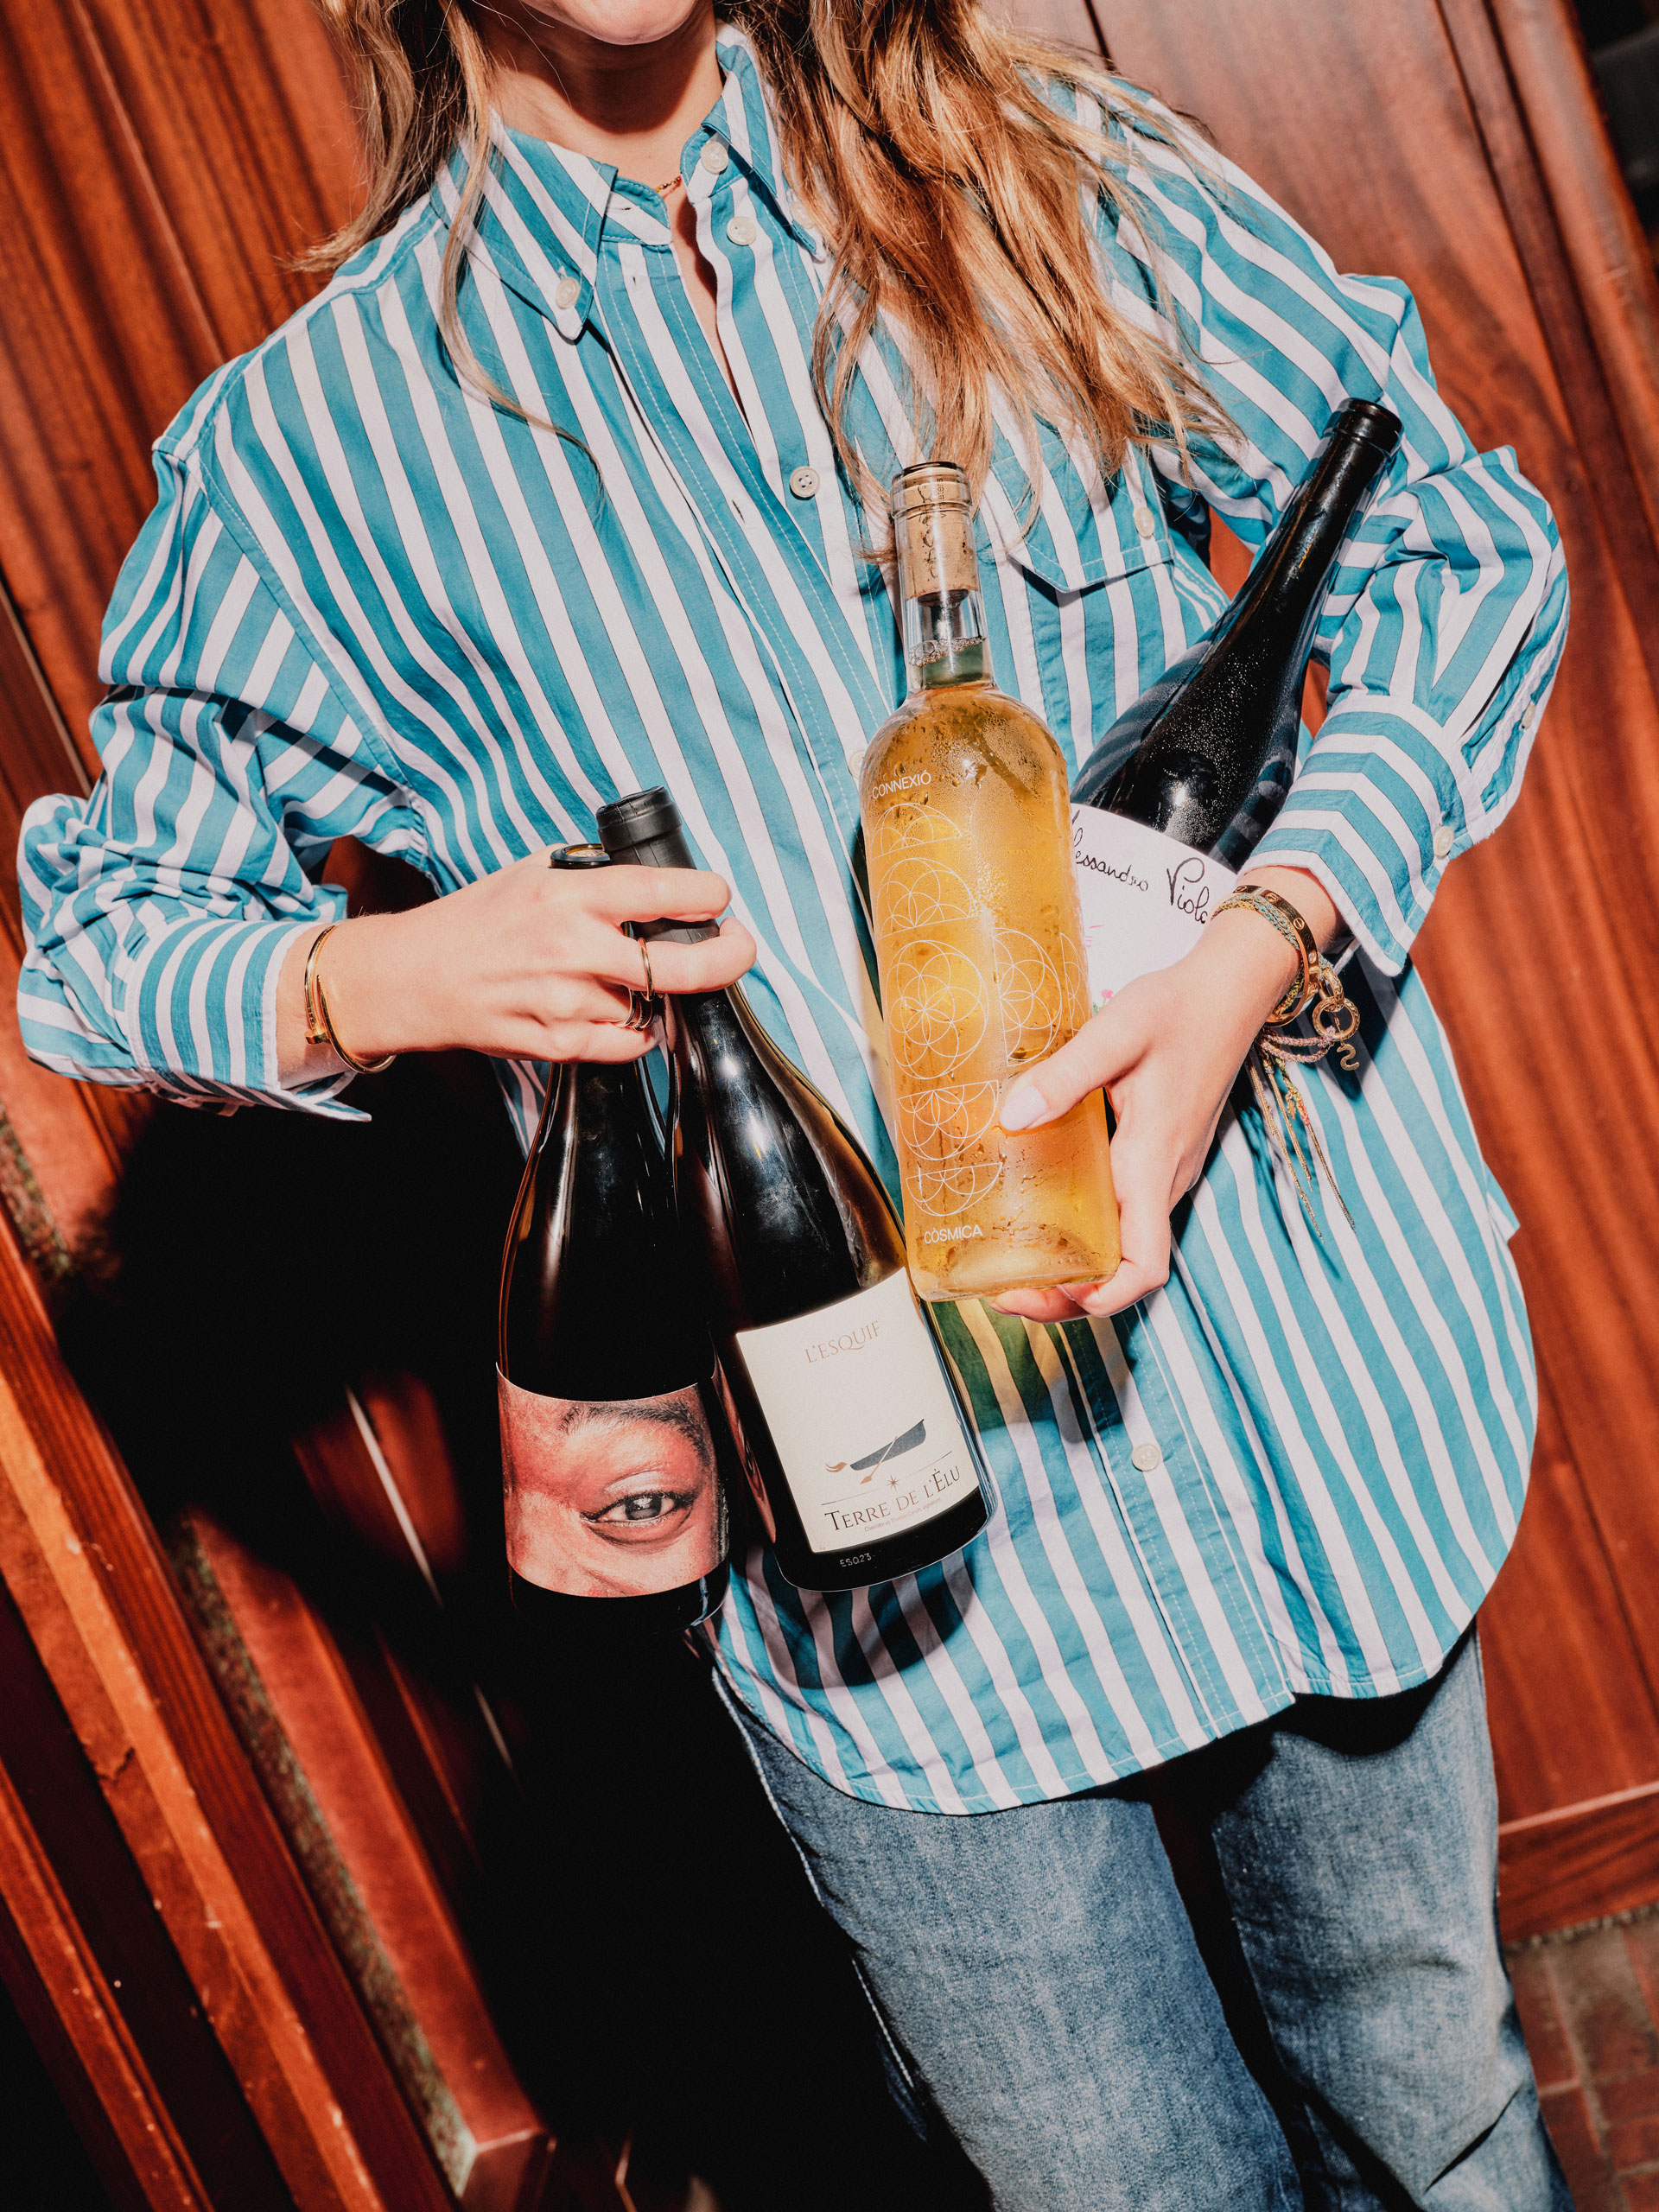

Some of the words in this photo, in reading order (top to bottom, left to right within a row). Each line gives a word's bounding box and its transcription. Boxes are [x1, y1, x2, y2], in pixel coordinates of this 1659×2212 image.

[1071, 810, 1148, 892] lessandro
[804, 1319, 880, 1363] L'ESQUIF
[824, 1502, 891, 1530] TERRE
[895, 1491, 919, 1511] DE
[839, 1553, 872, 1567] ESQ23
